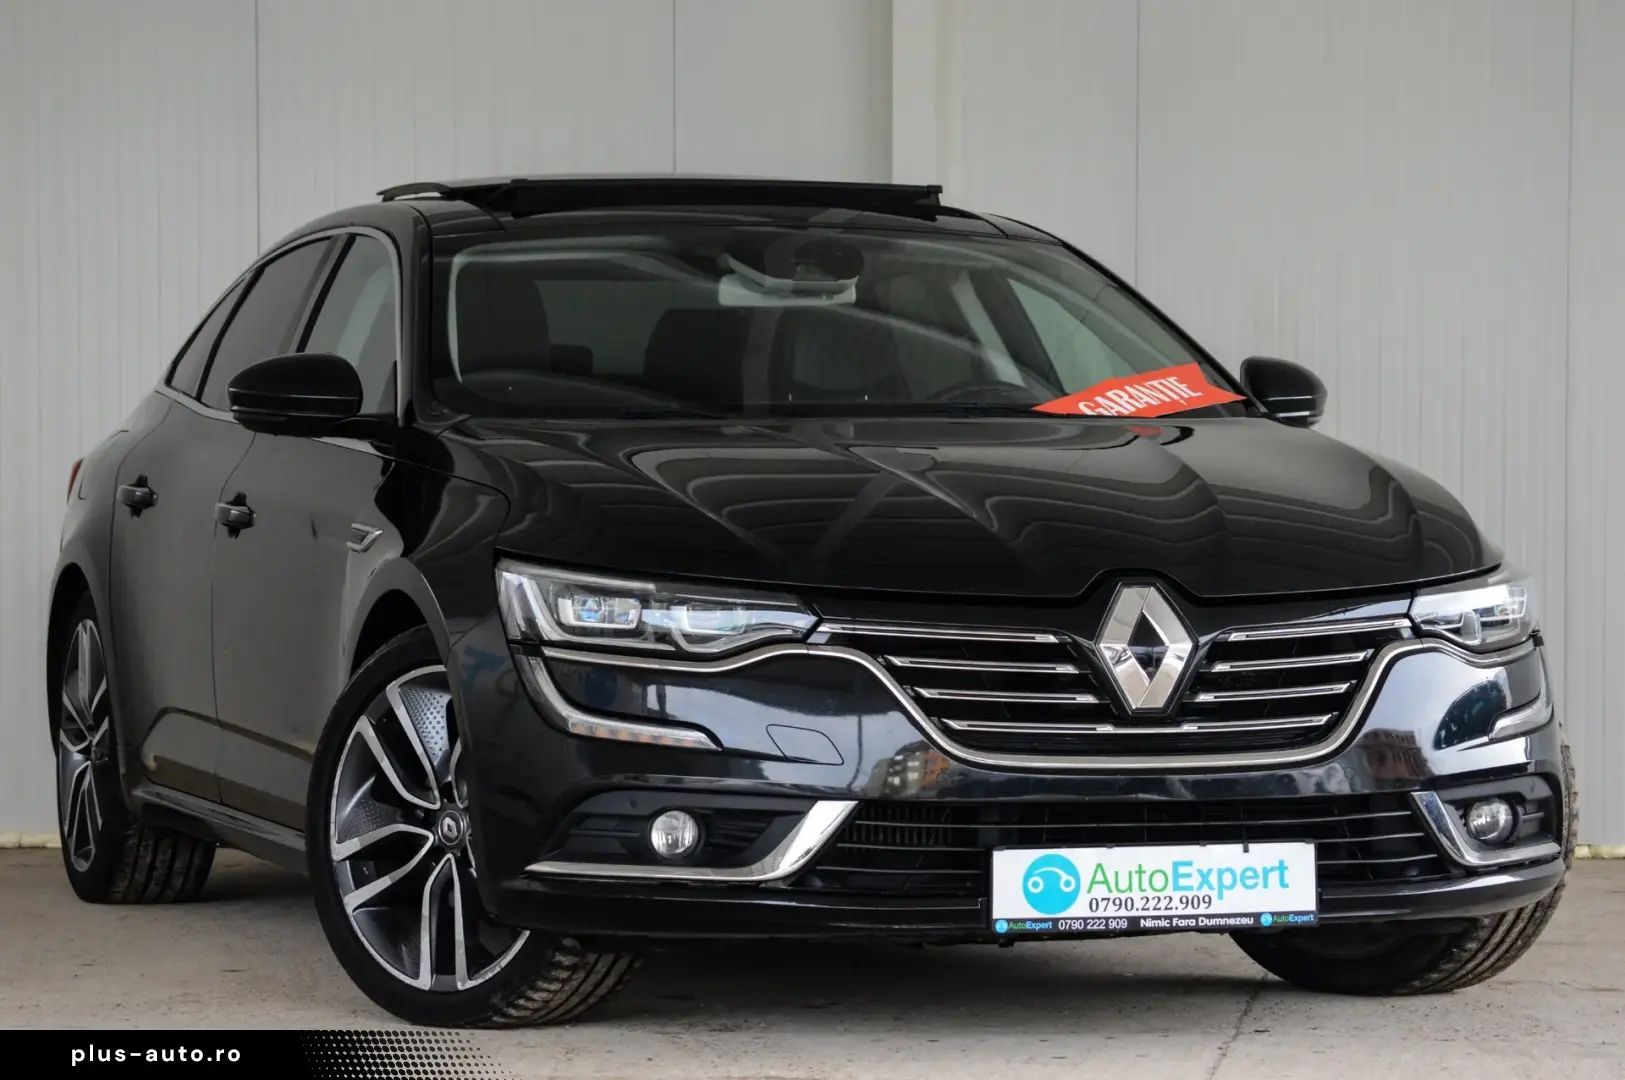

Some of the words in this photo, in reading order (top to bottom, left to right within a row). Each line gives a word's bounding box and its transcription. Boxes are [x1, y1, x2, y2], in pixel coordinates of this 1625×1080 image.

[1087, 860, 1290, 900] AutoExpert
[1089, 894, 1212, 913] 0790.222.909
[1008, 921, 1053, 931] AutoExpert
[1058, 919, 1085, 930] 0790
[1086, 919, 1106, 929] 222
[1108, 918, 1128, 929] 909
[1140, 917, 1170, 928] Nimic
[1172, 917, 1196, 927] Fara
[1198, 916, 1255, 927] Dumnezeu
[1272, 914, 1314, 925] AutoExpert
